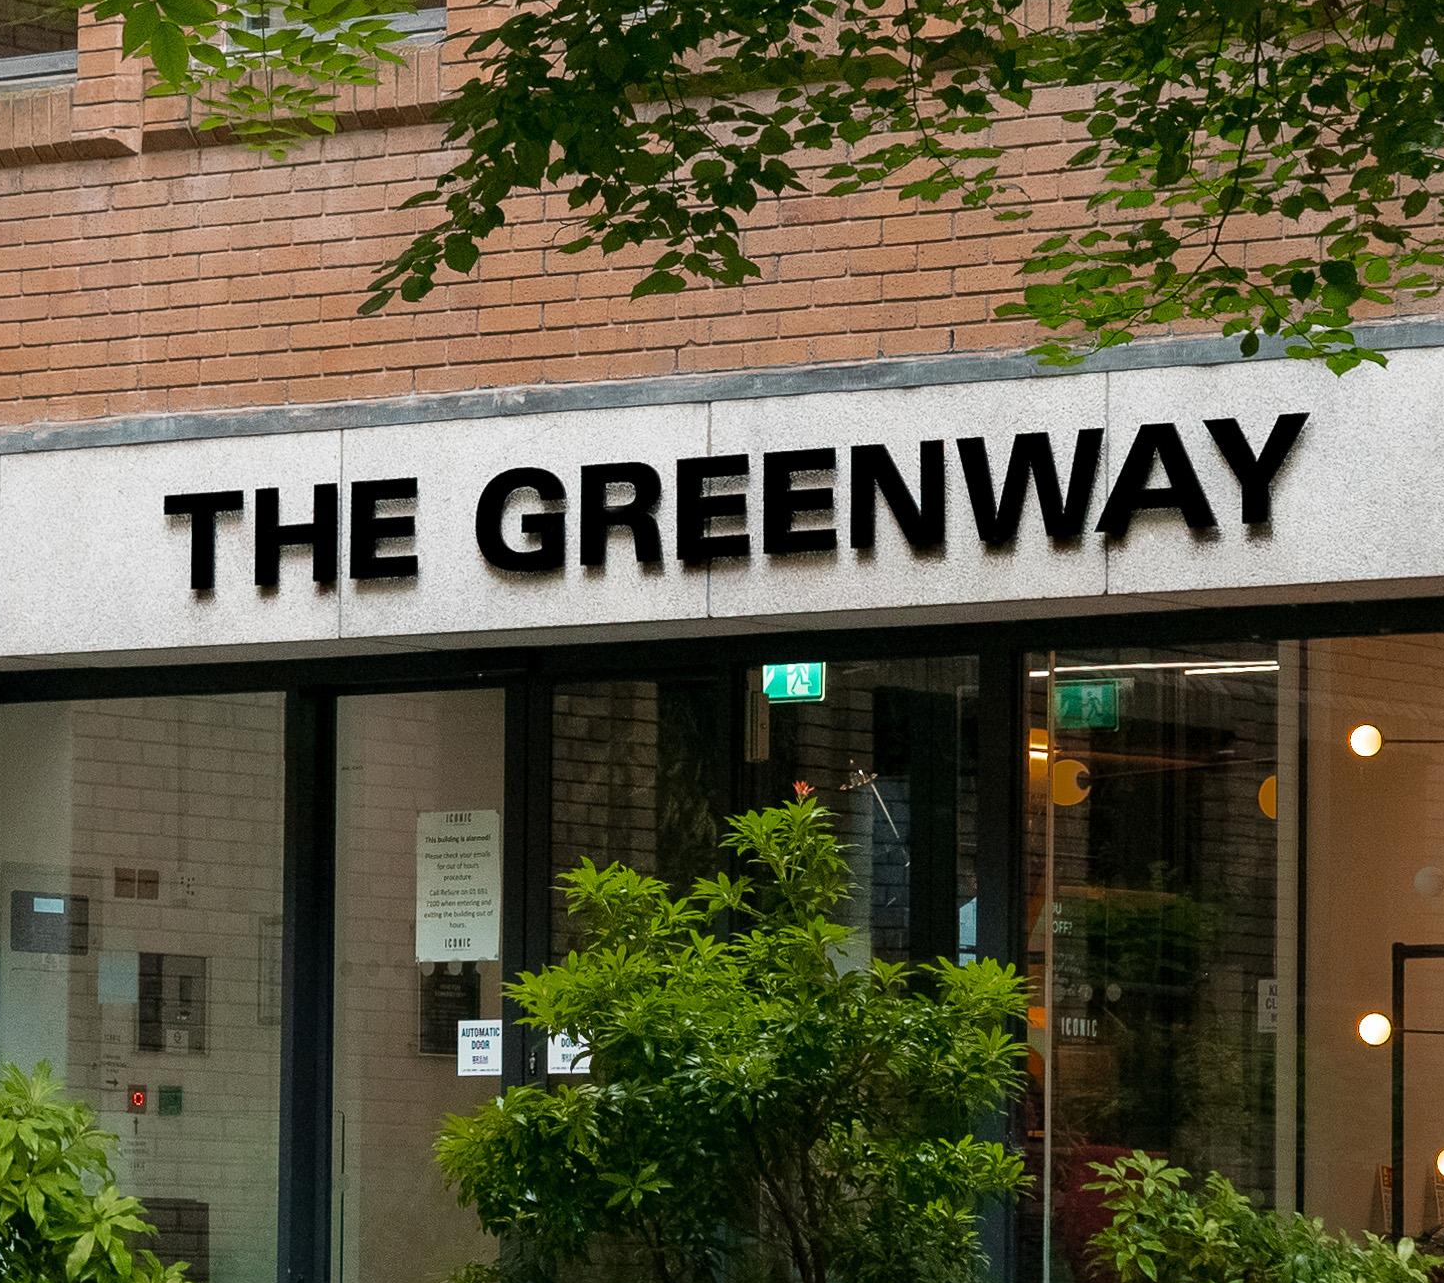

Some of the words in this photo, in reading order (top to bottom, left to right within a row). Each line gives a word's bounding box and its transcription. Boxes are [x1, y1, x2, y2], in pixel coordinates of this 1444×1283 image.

[164, 477, 418, 591] THE
[475, 412, 1311, 574] GREENWAY
[445, 813, 472, 823] ICONIC
[425, 836, 437, 844] This
[438, 835, 459, 844] building
[443, 851, 458, 859] check
[454, 910, 475, 918] building
[444, 938, 471, 948] ICONIC
[1061, 1017, 1098, 1037] ICONIC
[461, 1027, 500, 1038] AUTOMATIC
[471, 1039, 490, 1050] DOOR
